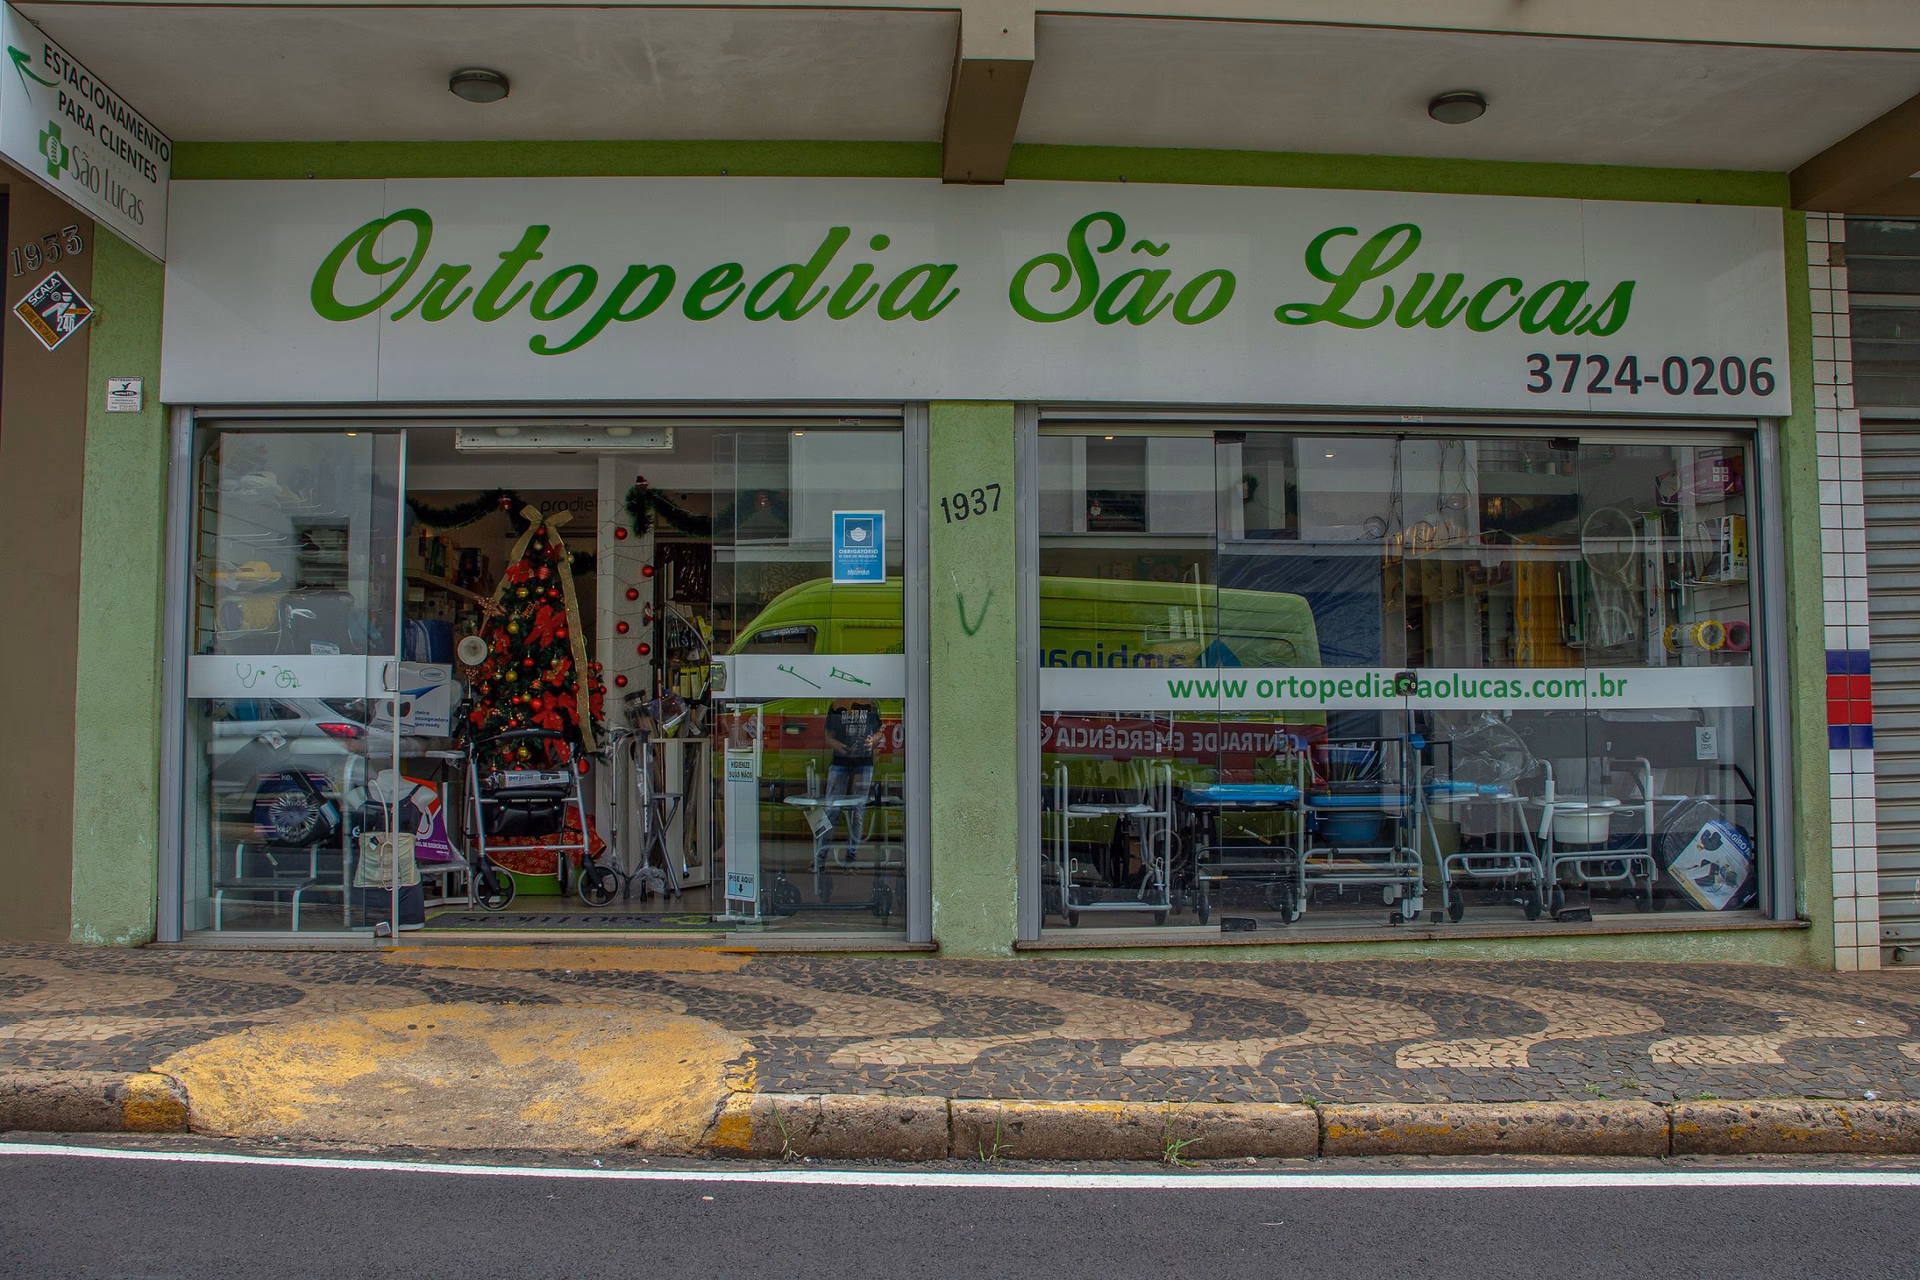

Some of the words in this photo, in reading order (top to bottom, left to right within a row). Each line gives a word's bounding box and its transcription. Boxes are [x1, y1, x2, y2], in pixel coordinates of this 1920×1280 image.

[44, 43, 169, 163] ESTACIONAMENTO
[58, 90, 96, 137] PARA
[100, 124, 157, 184] CLIENTES
[71, 145, 100, 194] São
[104, 168, 144, 226] Lucas
[11, 224, 83, 277] 1933
[28, 277, 60, 308] SCALA
[311, 208, 960, 356] Ortopedia
[1009, 211, 1237, 326] São
[1274, 223, 1636, 337] Lucas
[1526, 353, 1776, 396] 3724-0206
[541, 496, 599, 517] prodie
[941, 483, 1001, 524] 1937
[1731, 833, 1747, 850] GIRO
